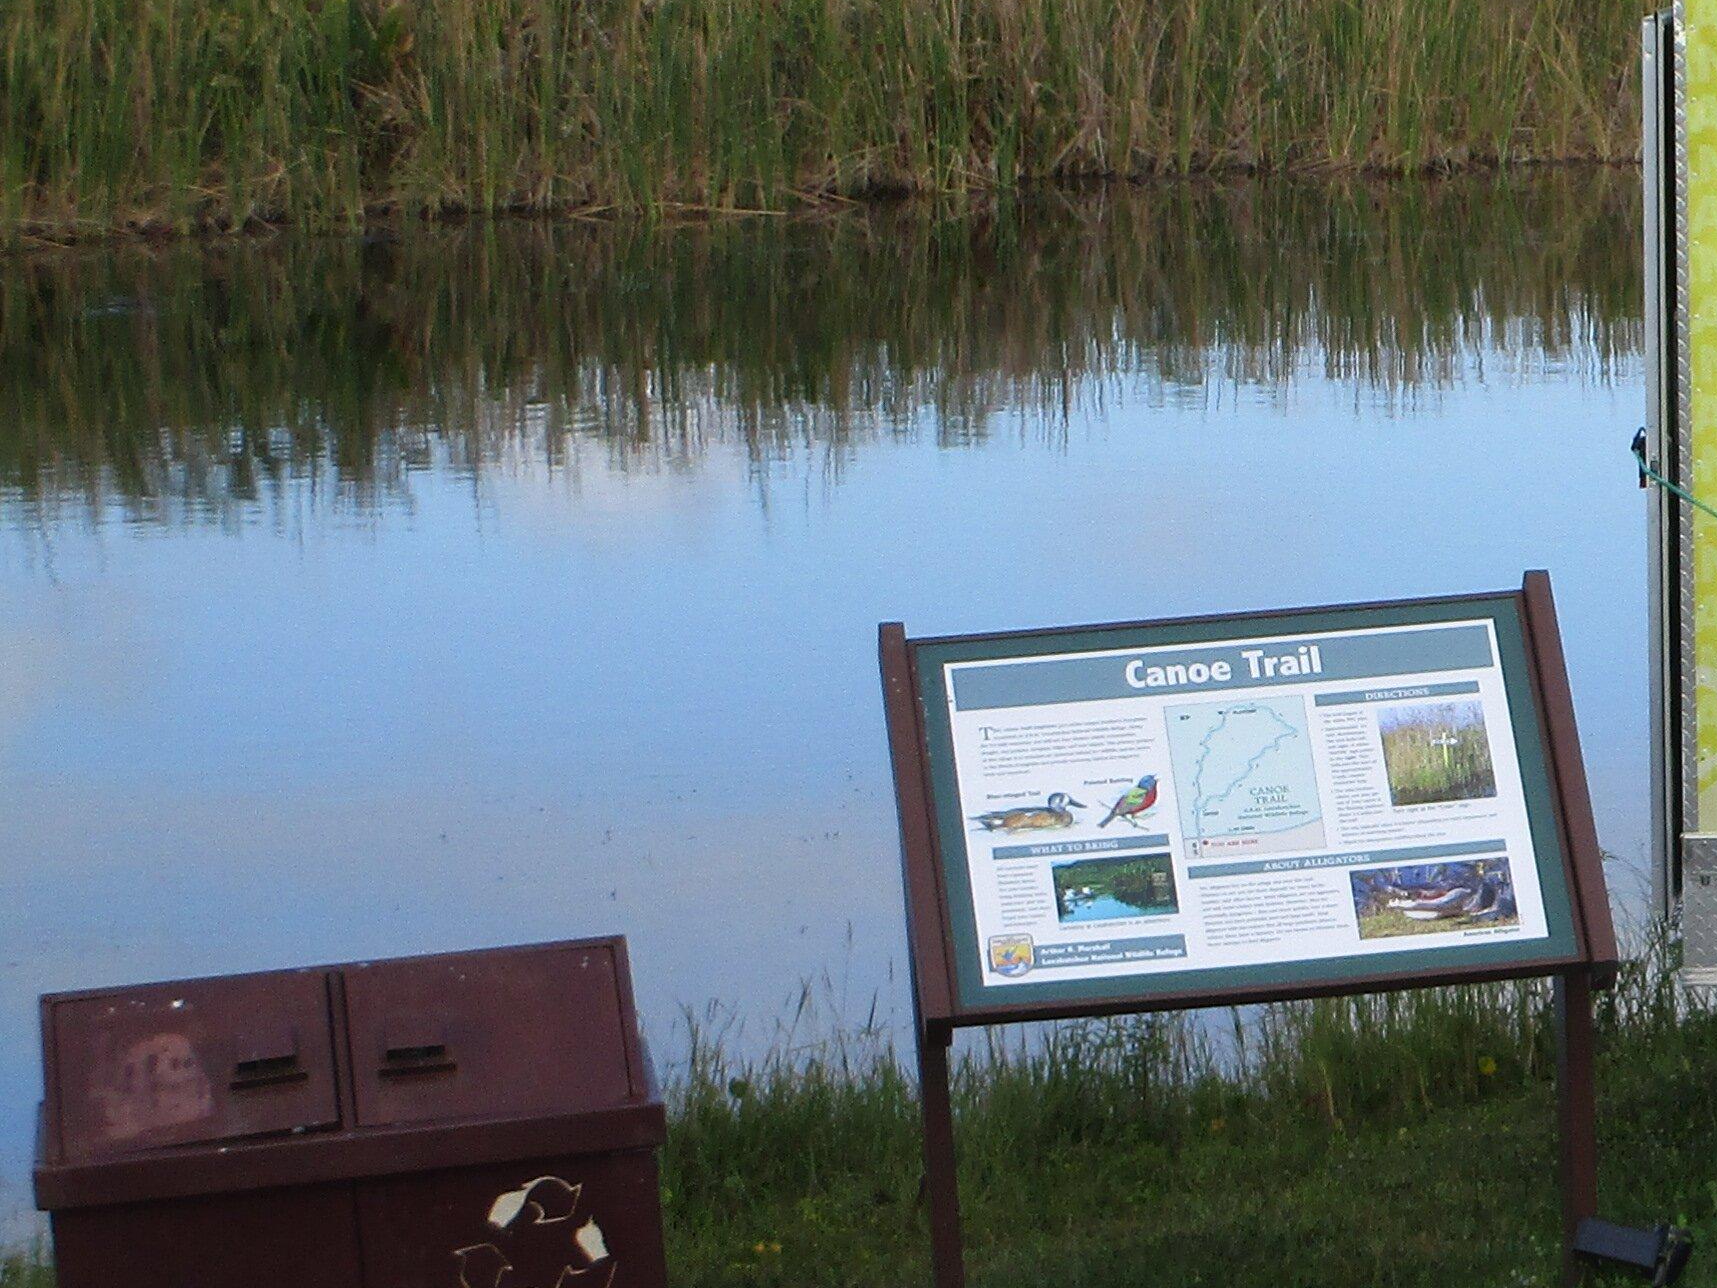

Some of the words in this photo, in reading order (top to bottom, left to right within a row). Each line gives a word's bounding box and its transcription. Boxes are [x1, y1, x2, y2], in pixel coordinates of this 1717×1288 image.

[1126, 659, 1232, 688] Canoe
[1241, 645, 1322, 679] Trail
[1366, 687, 1430, 701] DIRECTIONS
[1031, 845, 1063, 855] WHAT
[1264, 859, 1301, 871] ABOUT
[1304, 854, 1371, 868] ALLIGATORS
